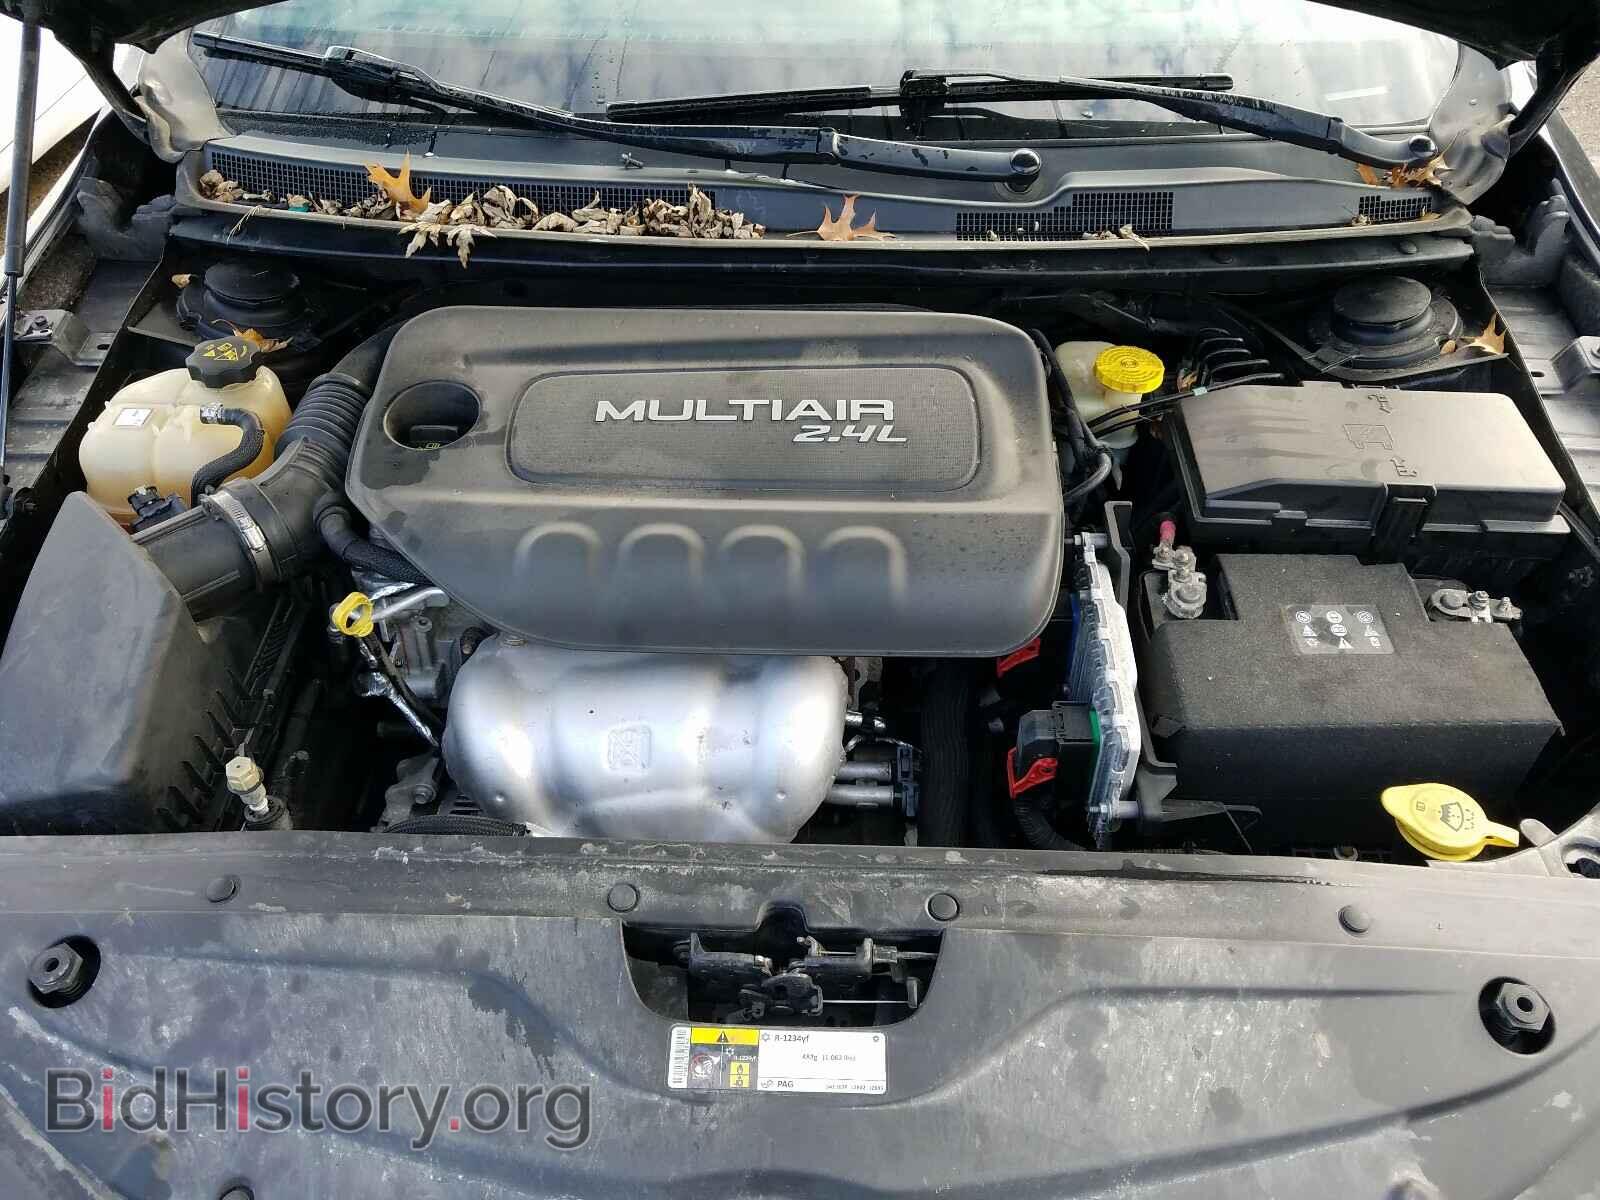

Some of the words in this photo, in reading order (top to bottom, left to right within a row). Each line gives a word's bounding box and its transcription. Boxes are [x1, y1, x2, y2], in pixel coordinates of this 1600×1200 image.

[594, 399, 895, 422] MULTIAIR
[792, 424, 909, 444] 2.4L
[777, 1080, 794, 1089] PAG
